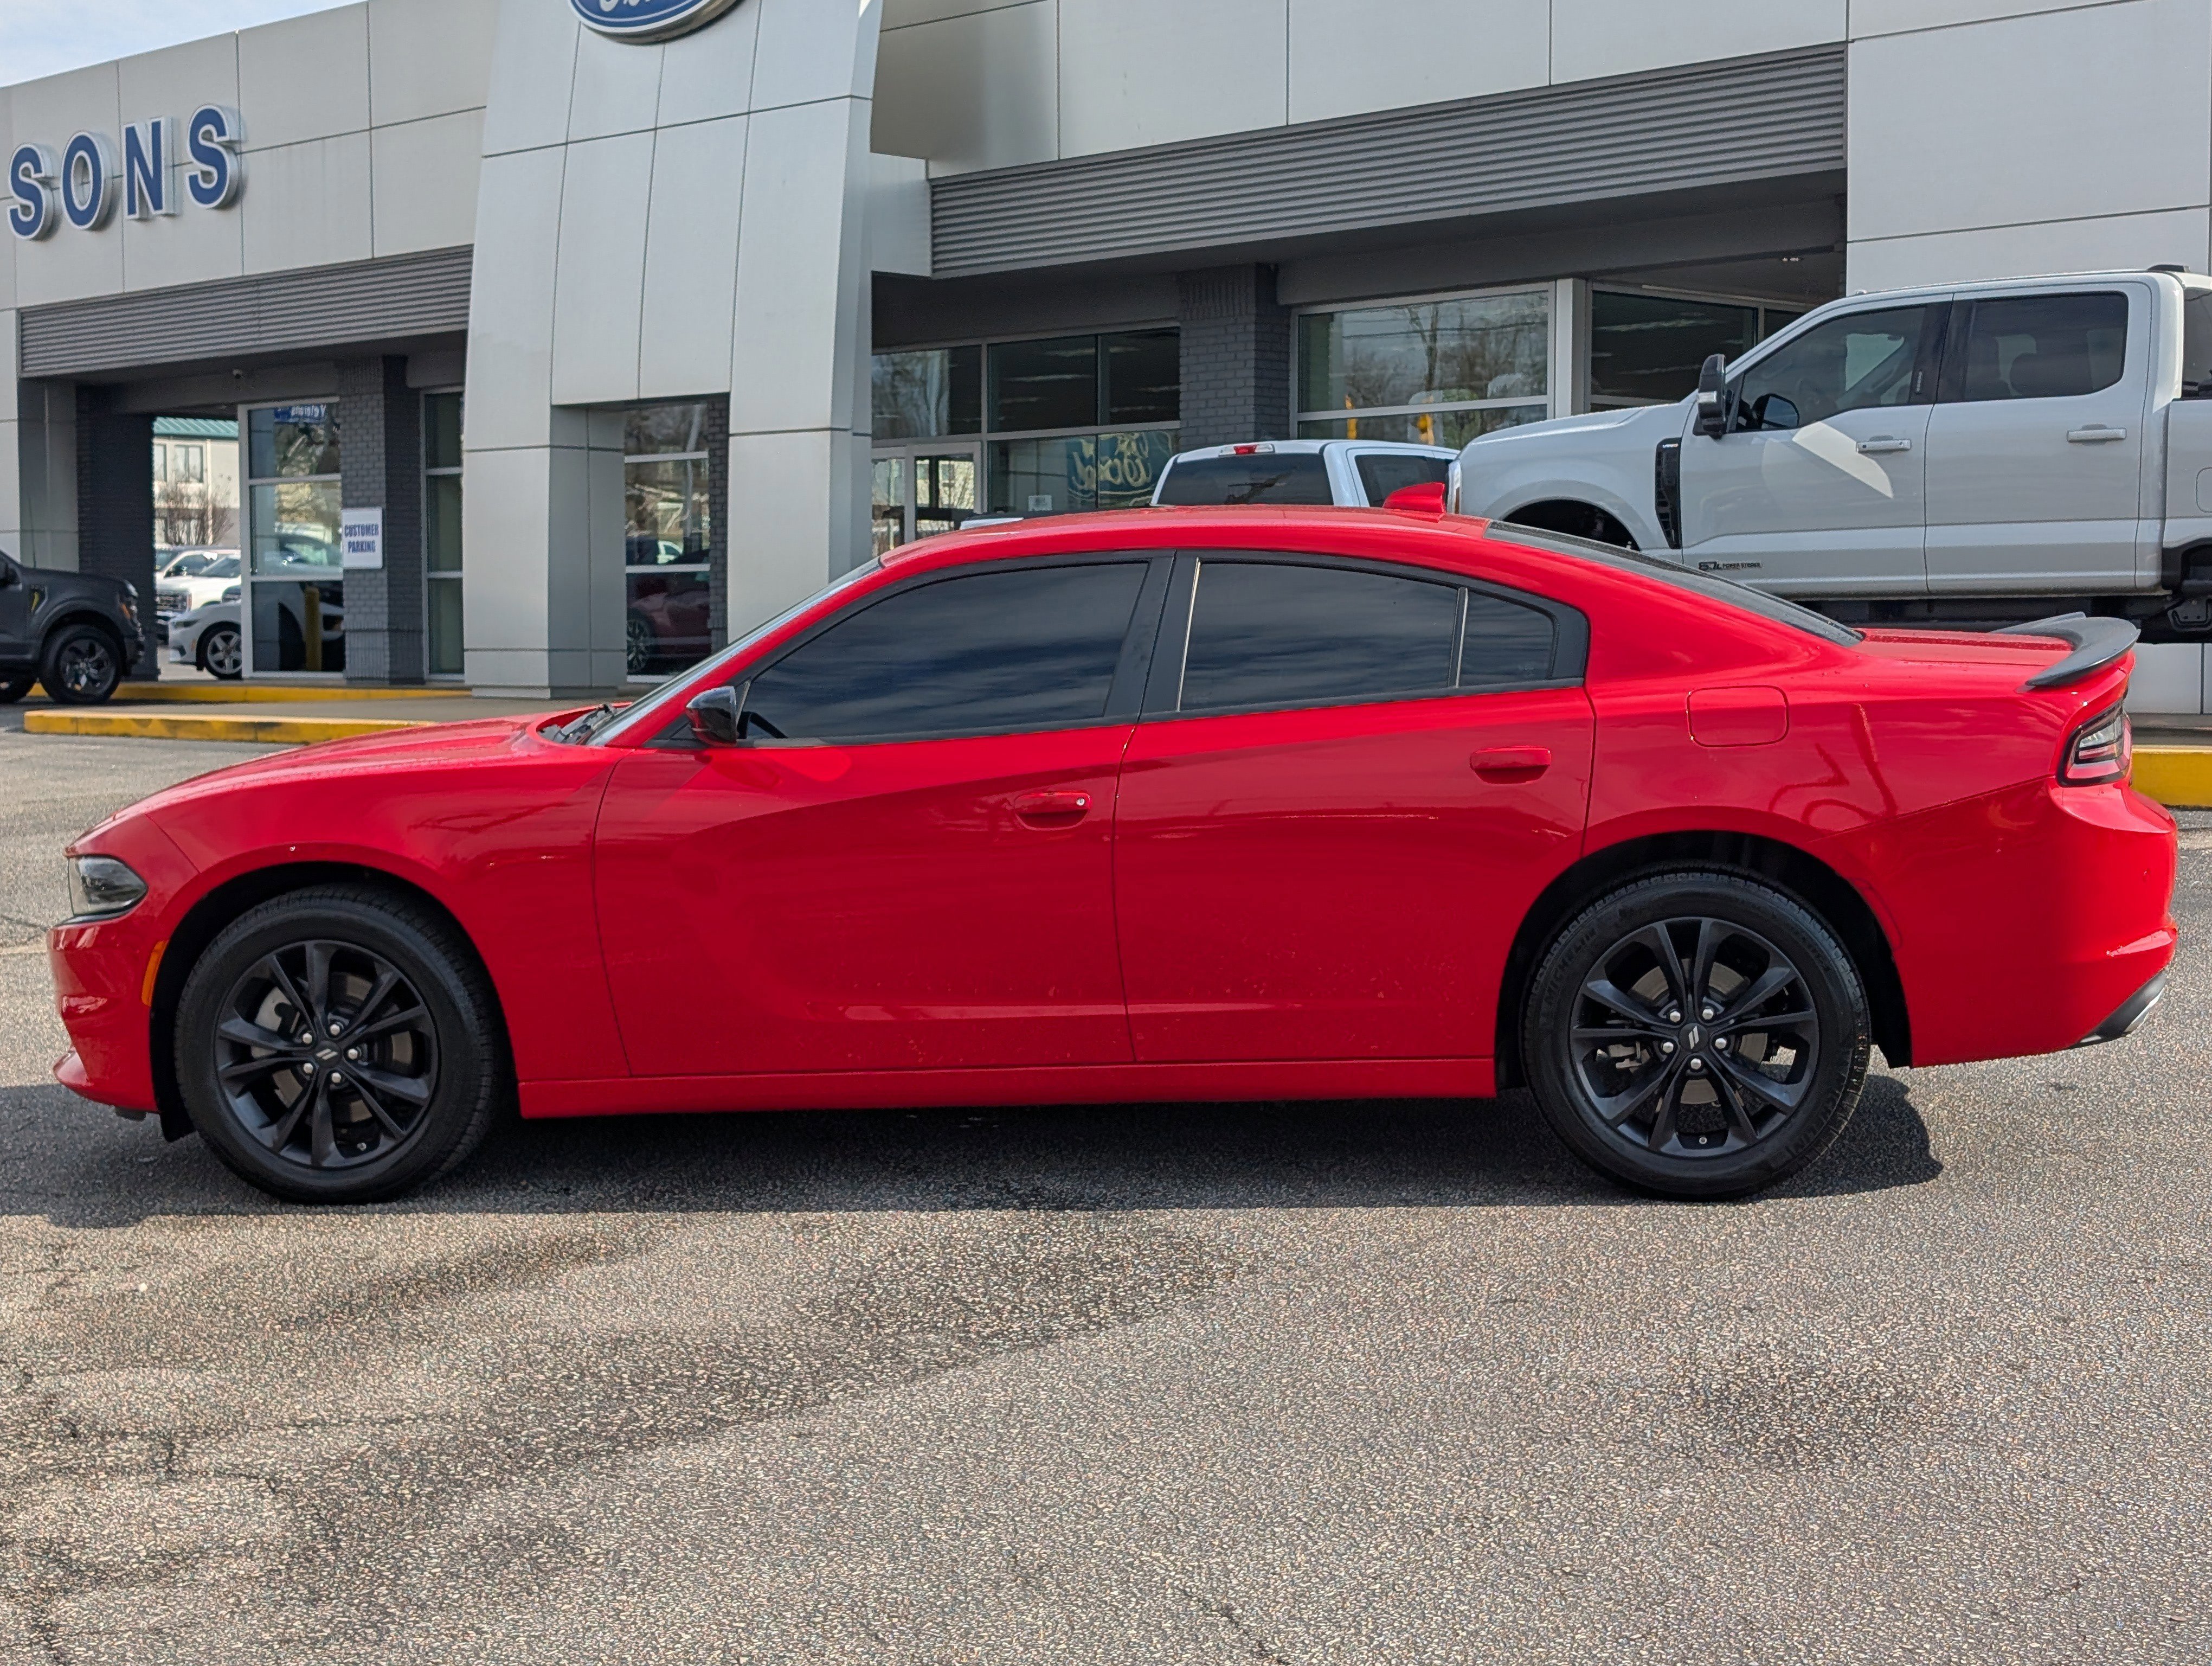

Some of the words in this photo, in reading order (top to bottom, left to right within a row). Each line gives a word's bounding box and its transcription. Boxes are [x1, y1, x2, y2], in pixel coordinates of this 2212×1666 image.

[7, 103, 240, 241] SONS
[344, 523, 379, 537] CUSTOMER
[348, 540, 376, 553] PARKING
